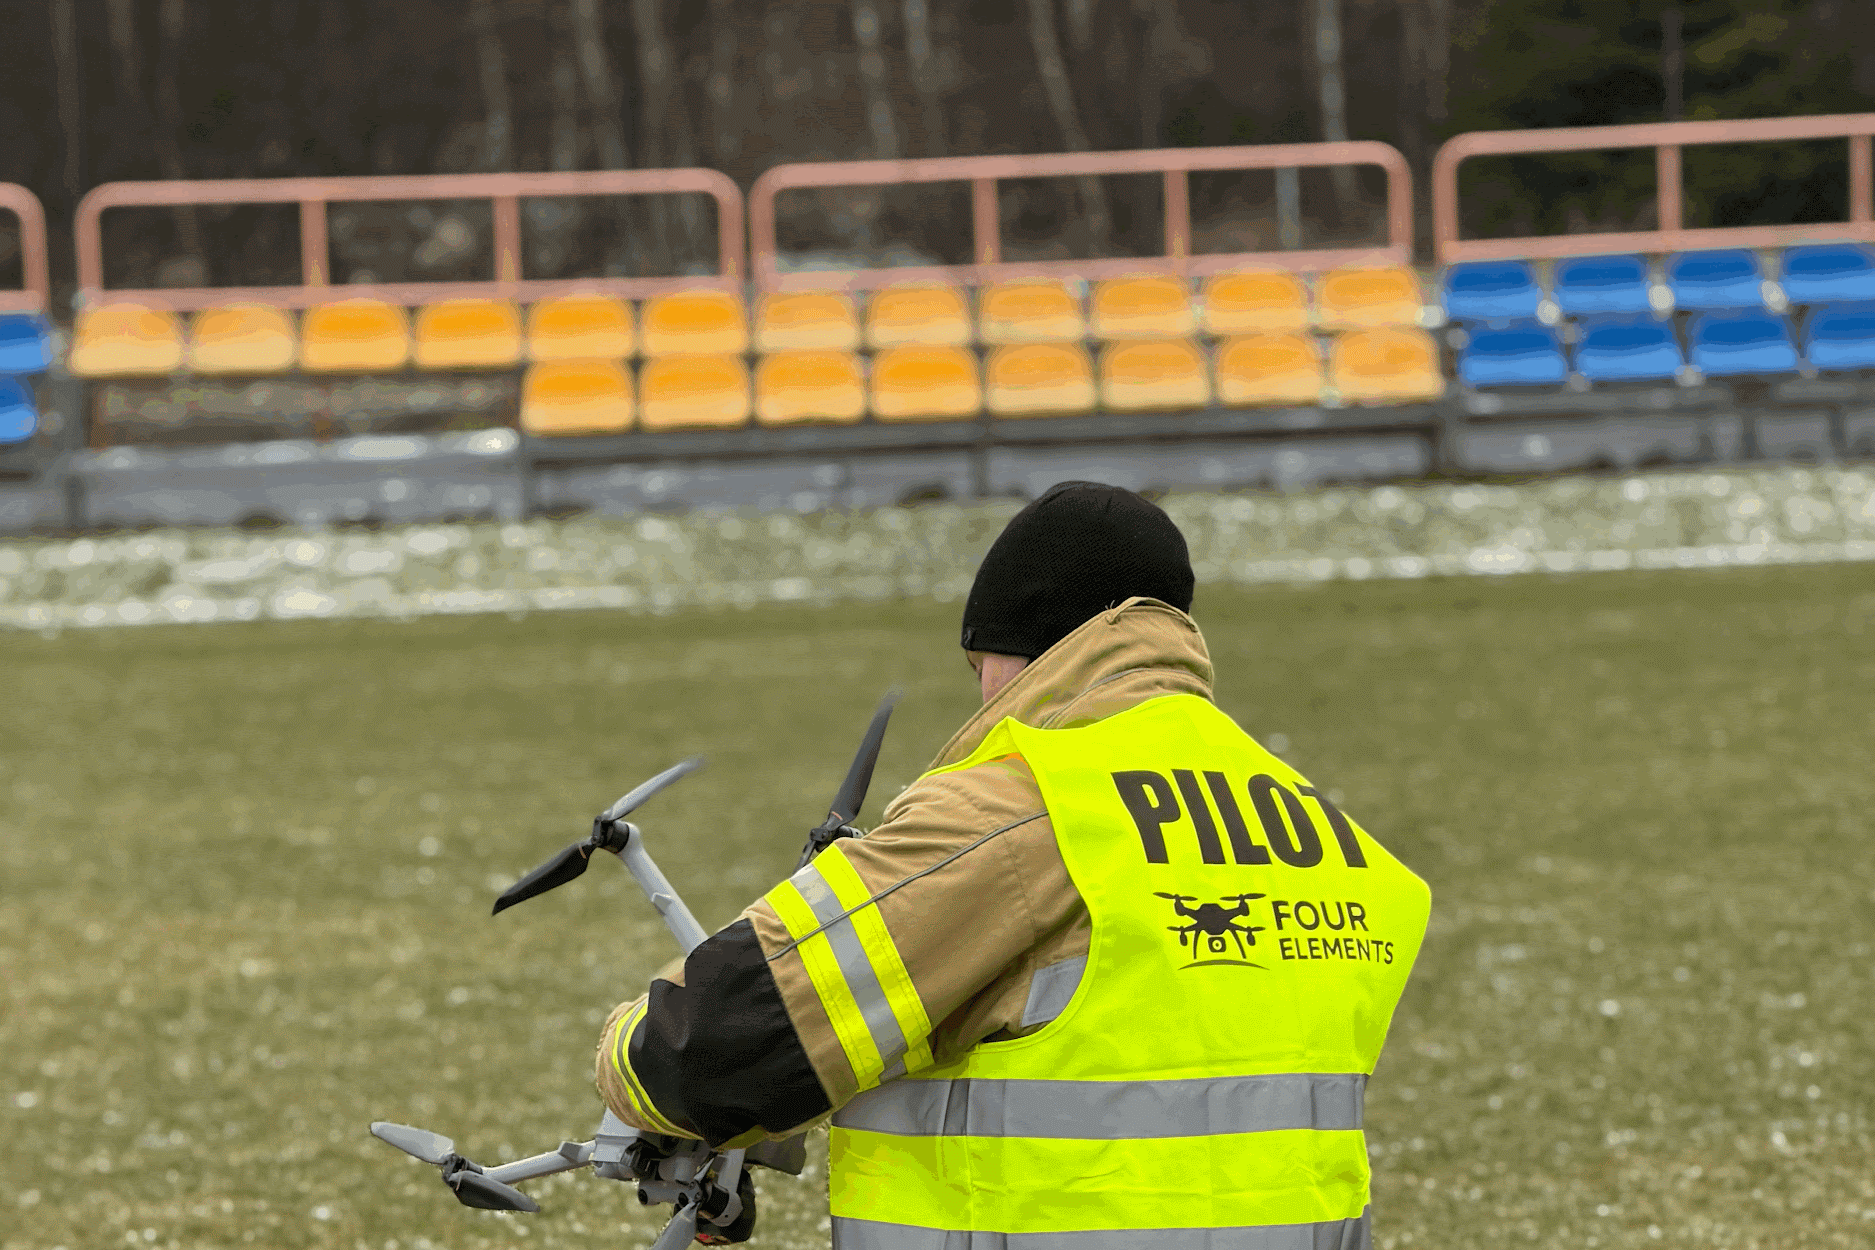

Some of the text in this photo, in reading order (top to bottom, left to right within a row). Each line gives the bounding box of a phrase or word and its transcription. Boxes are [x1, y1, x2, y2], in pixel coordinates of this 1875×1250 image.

[1110, 768, 1369, 869] PILOT
[1271, 900, 1370, 932] FOUR
[1278, 937, 1394, 965] ELEMENTS
